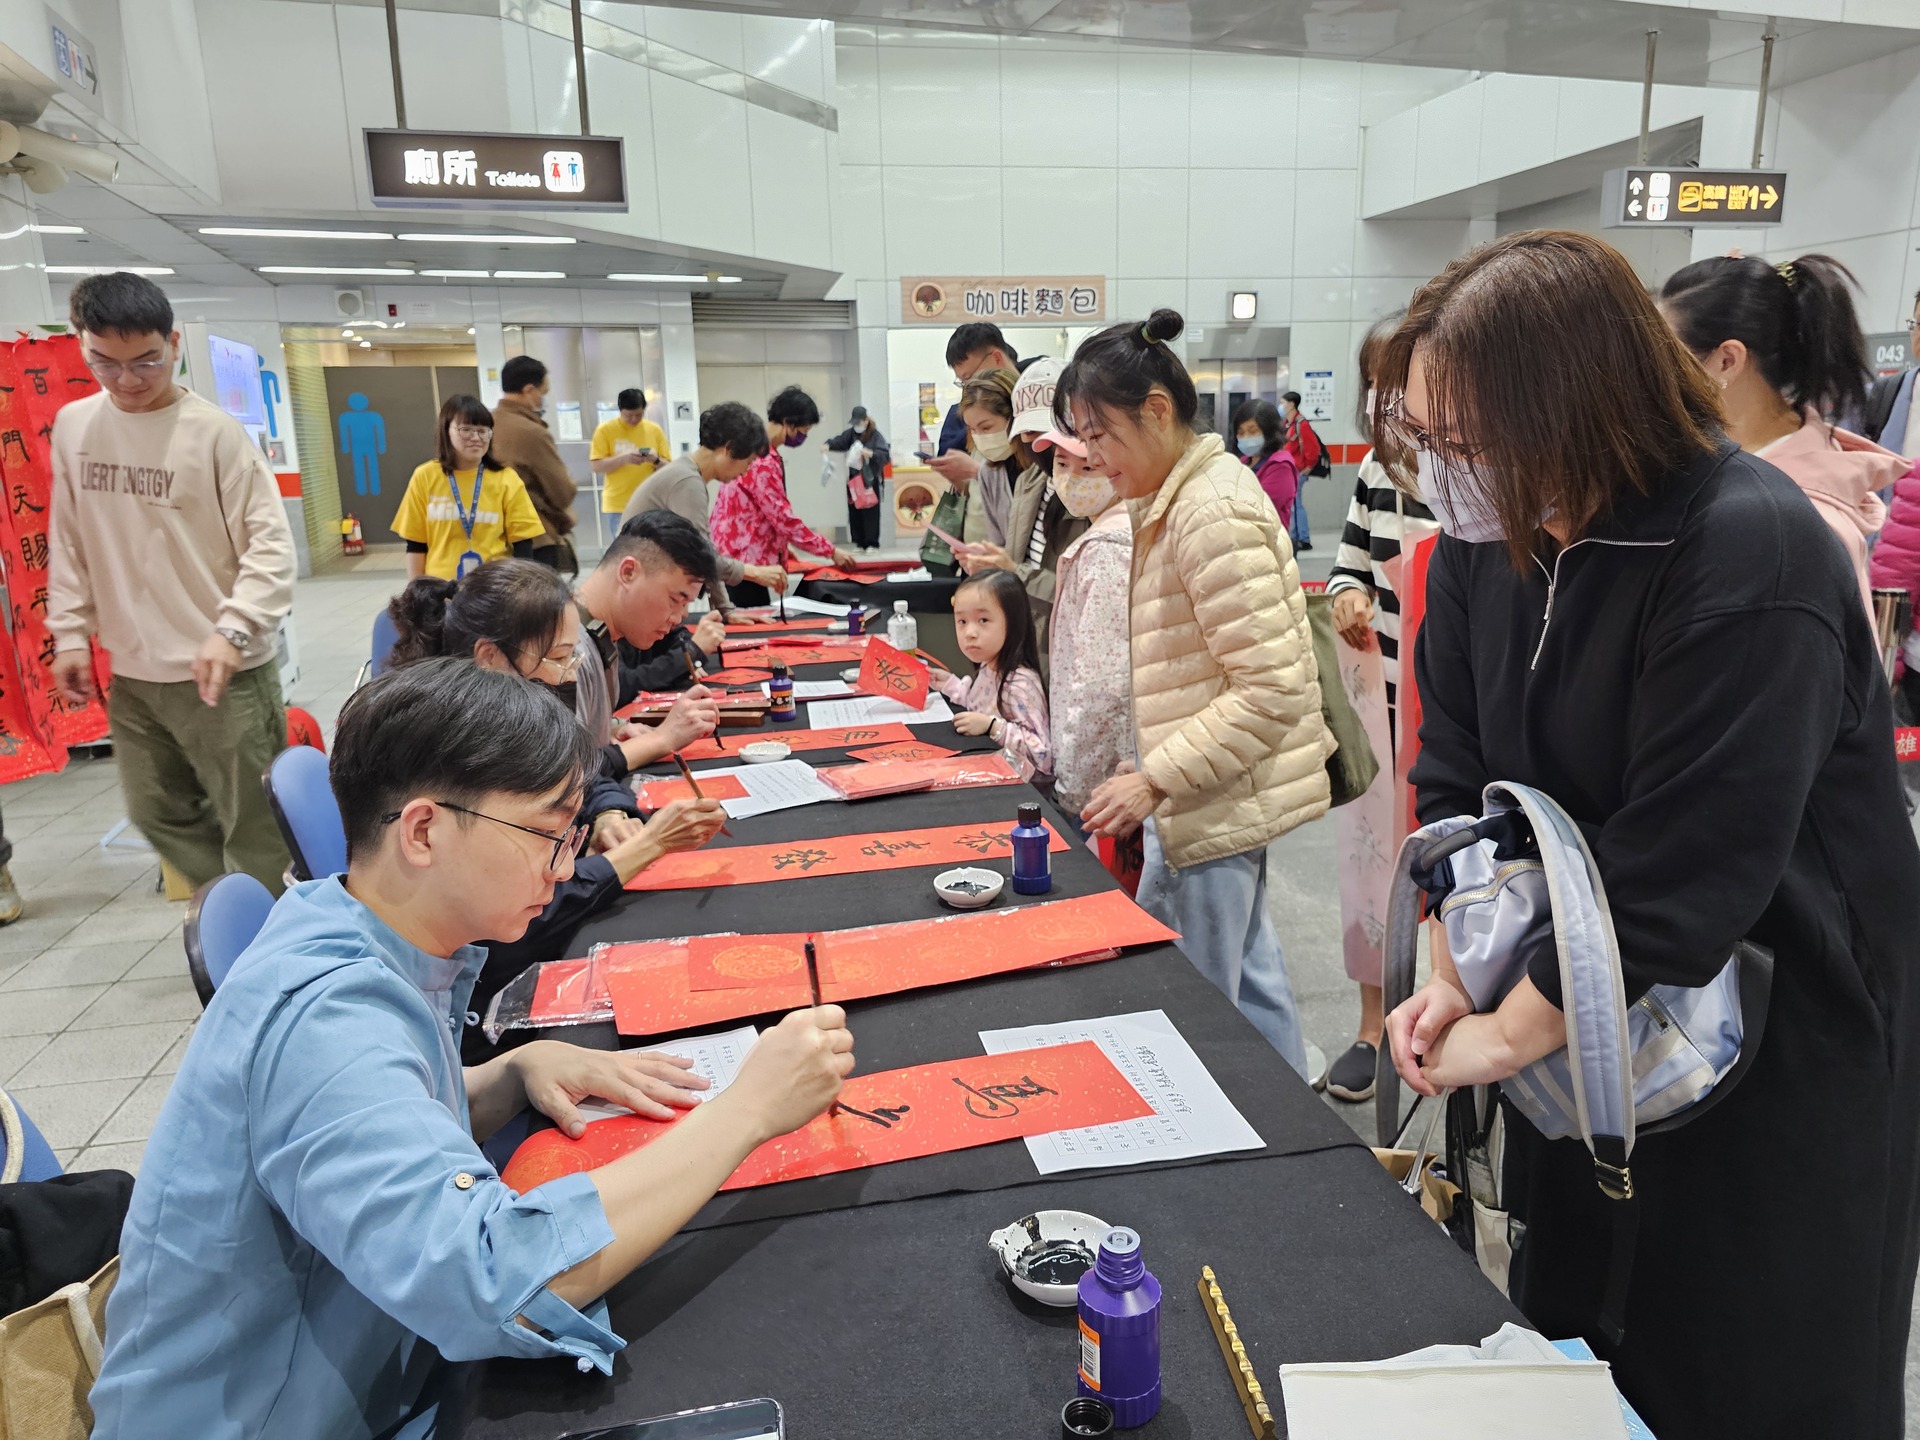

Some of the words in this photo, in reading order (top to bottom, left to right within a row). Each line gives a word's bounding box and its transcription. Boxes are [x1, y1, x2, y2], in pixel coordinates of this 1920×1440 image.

[404, 149, 478, 186] 廁所
[485, 171, 541, 188] Toilets
[1748, 185, 1759, 210] 1
[965, 287, 1097, 316] 咖啡麵包
[1876, 344, 1905, 363] 043
[1014, 383, 1056, 414] NYC
[875, 657, 915, 692] 春
